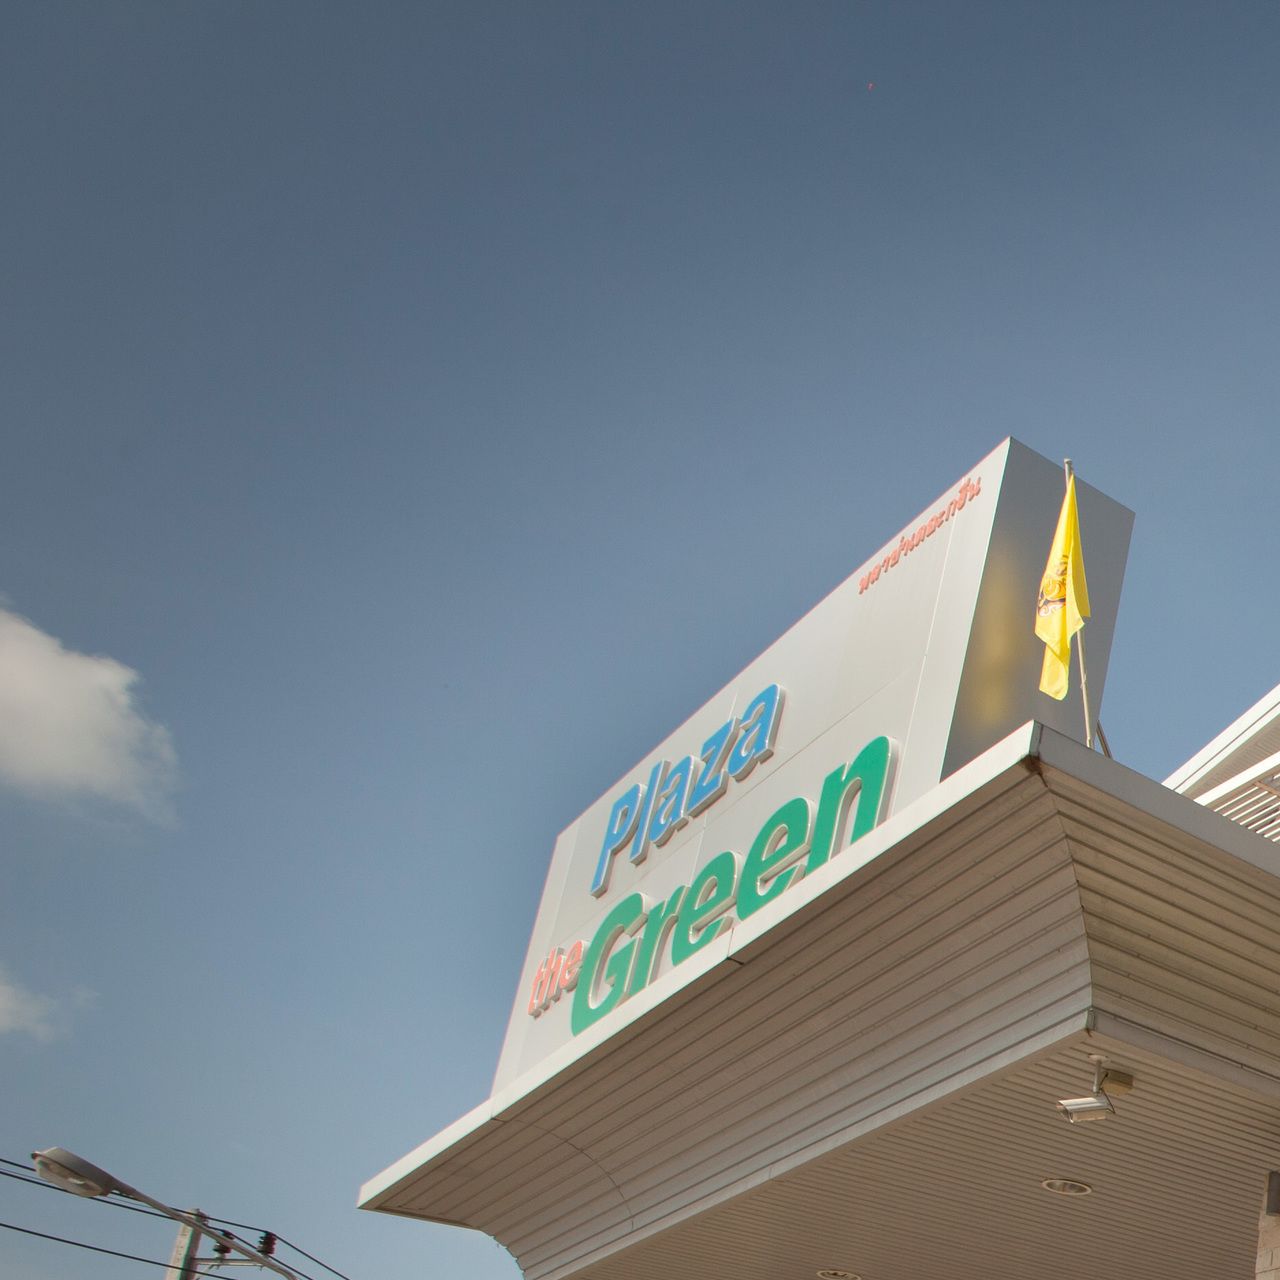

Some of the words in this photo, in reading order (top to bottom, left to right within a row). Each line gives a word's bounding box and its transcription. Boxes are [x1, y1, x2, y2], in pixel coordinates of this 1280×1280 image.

[528, 940, 588, 1017] the
[571, 736, 896, 1036] Green
[590, 684, 784, 896] Plaza
